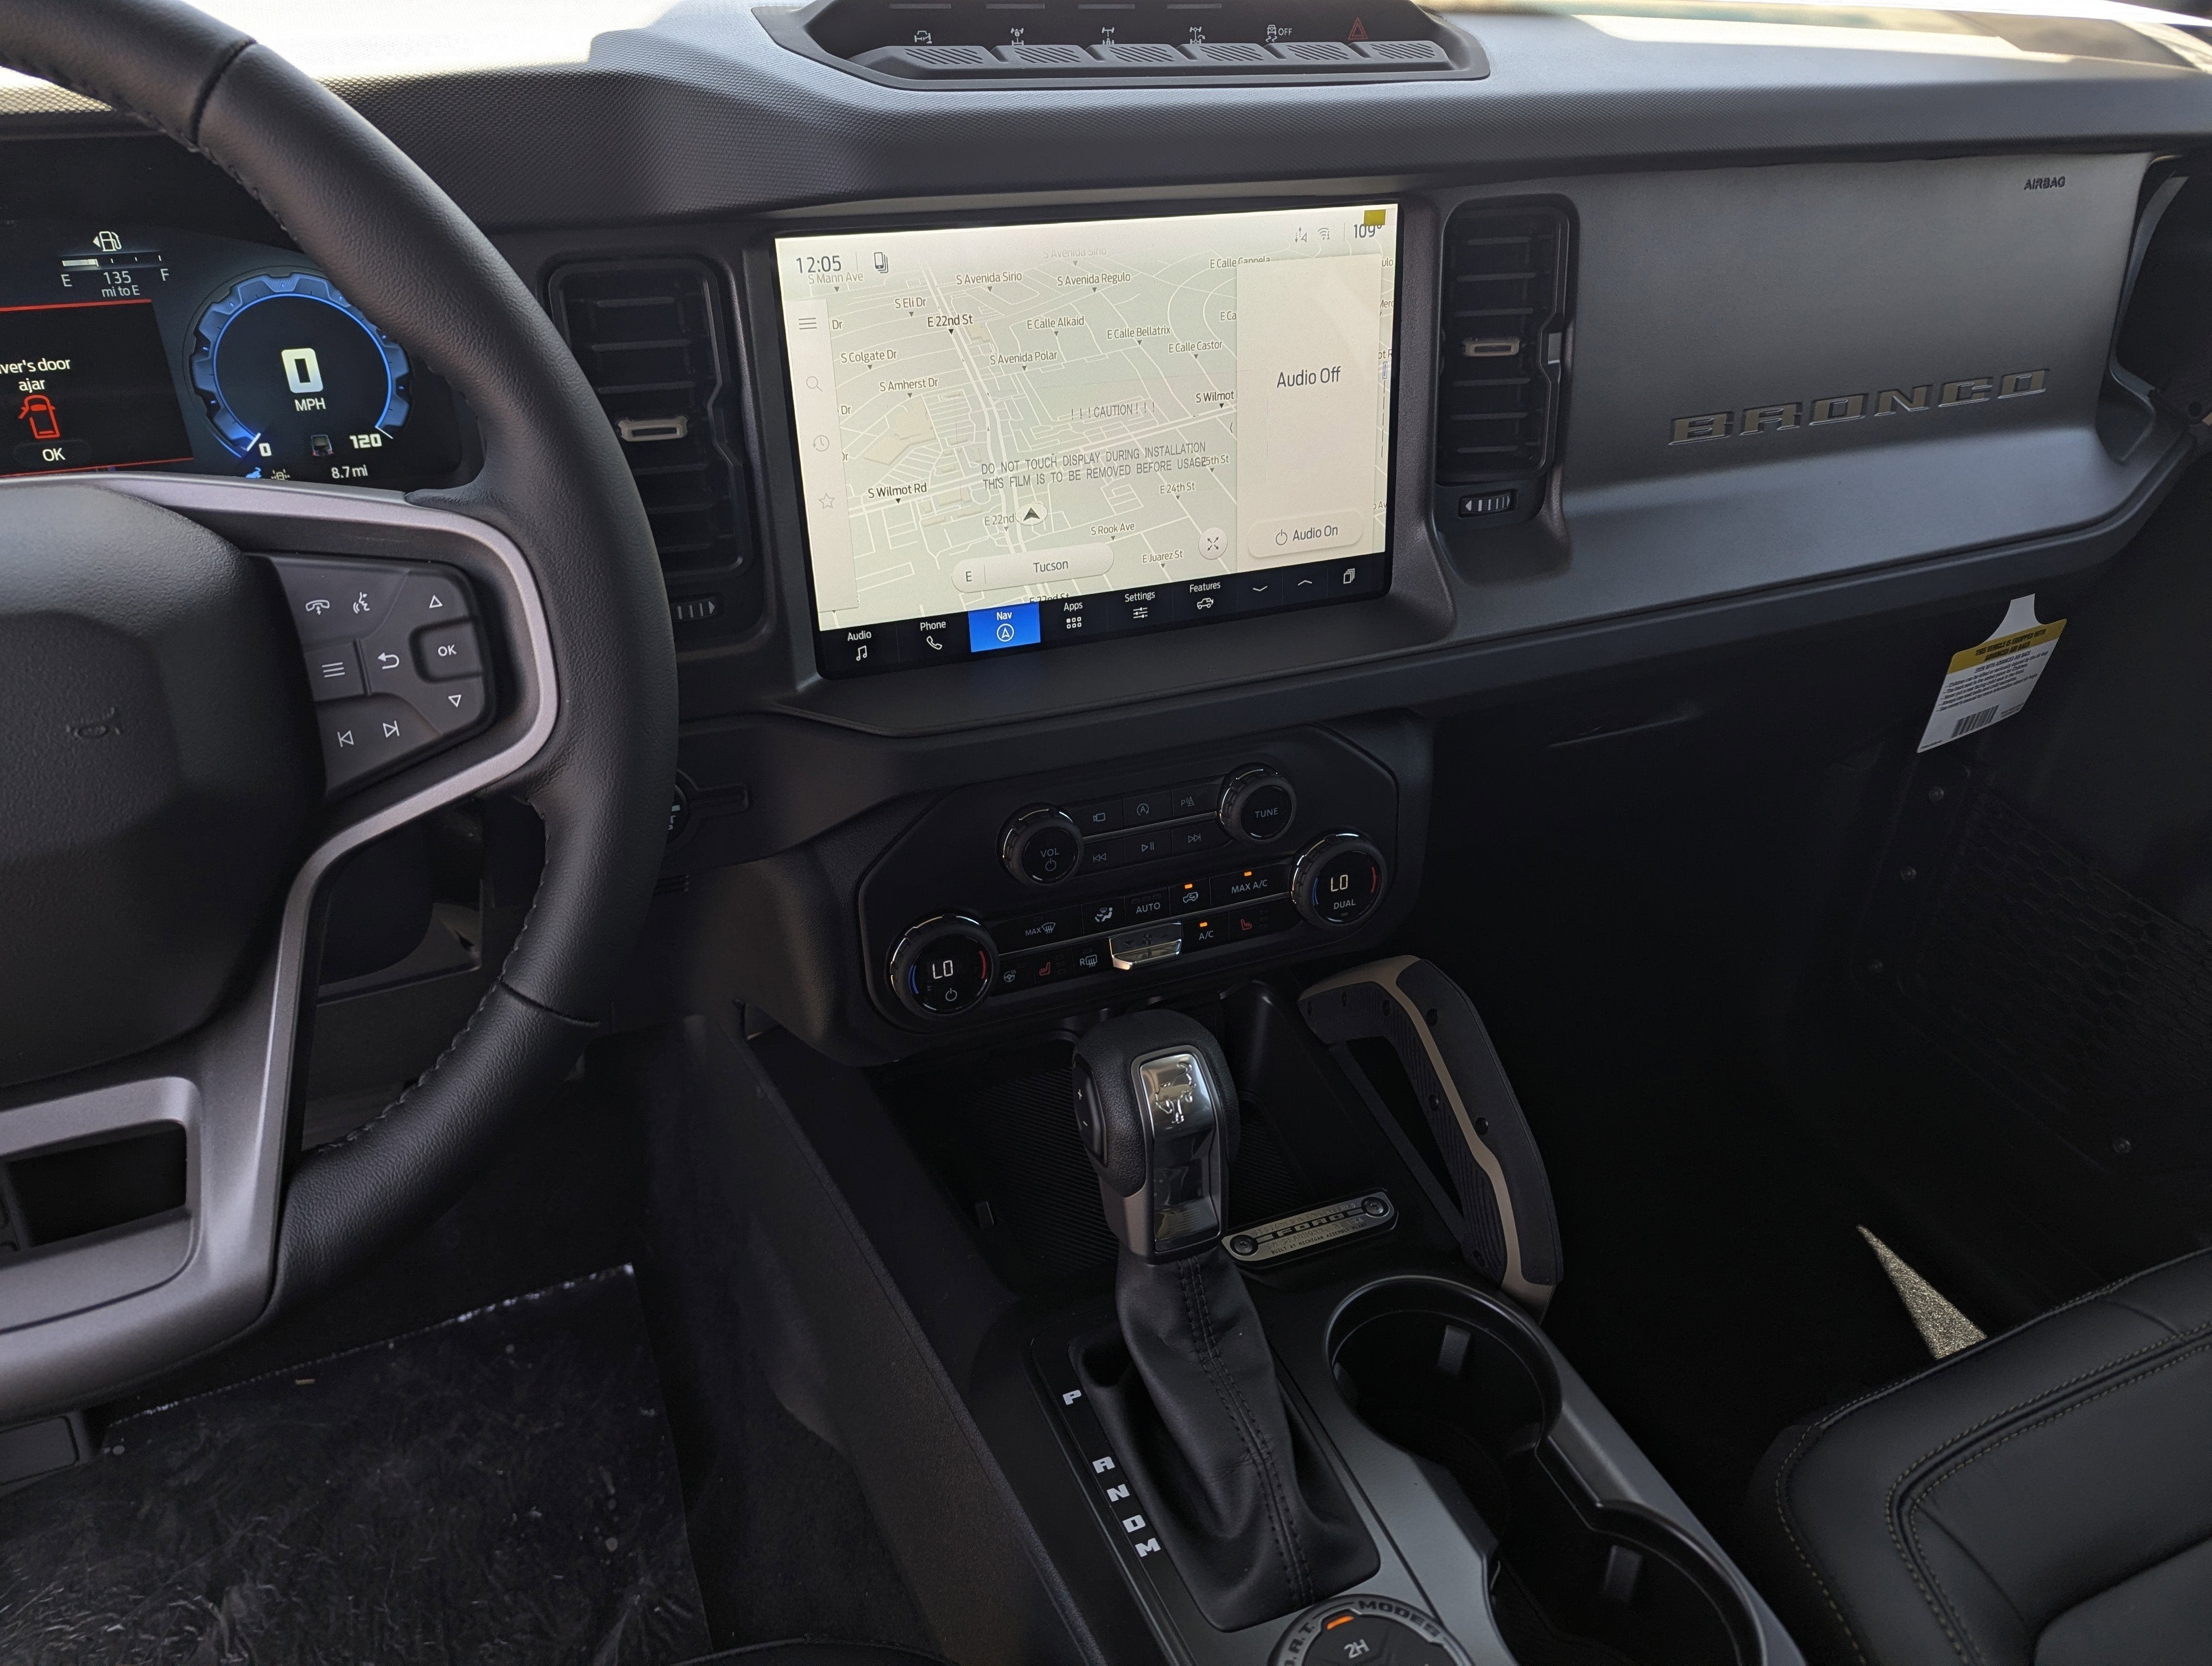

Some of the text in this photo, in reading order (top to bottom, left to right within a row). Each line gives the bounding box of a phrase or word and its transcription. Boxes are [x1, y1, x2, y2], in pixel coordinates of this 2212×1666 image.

[2024, 176, 2065, 190] AIRBAG
[796, 255, 841, 273] 12:05
[1211, 259, 1215, 268] E
[1217, 258, 1236, 268] Calle
[61, 274, 72, 287] E
[104, 271, 131, 284] 135
[160, 269, 169, 281] F
[808, 272, 864, 285] S Mann Ave
[956, 272, 1022, 285] S Avenida Sirio
[1057, 272, 1130, 286] S Avenida Regulo
[102, 285, 140, 297] mi to E
[895, 297, 927, 309] S Eli Dr
[928, 314, 973, 327] E 22nd St
[1027, 316, 1084, 329] E Calle Alkaid
[1220, 312, 1225, 321] E
[832, 320, 842, 330] Dr
[1107, 326, 1171, 339] E Calle Bellatrix
[1169, 340, 1223, 353] E Calle Castor
[841, 350, 897, 364] S Colgate Dr
[990, 350, 1057, 365] S Avenida Polar
[0, 358, 70, 374] ver's door
[281, 348, 323, 394] 0
[1277, 366, 1341, 388] Audio Off
[19, 378, 45, 393] ajar
[880, 379, 938, 391] S Amherst Dr
[1196, 393, 1201, 403] S
[1204, 390, 1234, 401] Wilmot
[295, 398, 326, 412] MPH
[841, 406, 851, 415] Dr
[1669, 368, 2049, 445] BRONCO
[350, 434, 382, 449] 120
[42, 448, 65, 462] OK
[259, 444, 272, 457] 0
[982, 442, 1206, 475] DO NOT TOUCH DISPLAY DURING INSTALLATION
[1221, 455, 1229, 464] St
[331, 464, 368, 479] 8.7 mi
[983, 457, 1206, 490] THIS FILM IS TO BE REMOVED BEFORE USAGE
[868, 483, 927, 498] S Wilmot Rd
[1160, 482, 1195, 494] E 24th St
[985, 517, 989, 526] E
[991, 514, 1014, 525] 22nd
[1091, 523, 1135, 536] S Rook Ave
[1293, 525, 1338, 541] Audio On
[1142, 550, 1183, 563] E Juarez St
[1033, 560, 1068, 573] Tucson
[966, 572, 972, 582] E
[1189, 581, 1220, 593] Features
[1125, 590, 1155, 603] Settings
[1064, 602, 1083, 612] Apps
[997, 612, 1012, 620] Nav
[921, 620, 946, 631] Phone
[847, 631, 871, 642] Audio
[438, 645, 456, 657] OK
[1255, 808, 1278, 818] TUNE
[1040, 848, 1059, 857] VOL
[1231, 879, 1268, 893] MAX A/C
[1136, 902, 1160, 913] AUTO
[1334, 899, 1355, 909] DUAL
[1025, 927, 1041, 936] MAX
[1199, 931, 1213, 940] A/C
[1276, 1213, 1344, 1236] FORD
[1299, 1236, 1323, 1246] MICHIGAN
[1326, 1228, 1349, 1238] ASSEMBLY
[1063, 1390, 1082, 1405] P
[1092, 1457, 1115, 1473] R
[1107, 1484, 1130, 1502] N
[1122, 1515, 1146, 1533] D
[1135, 1537, 1161, 1557] M
[1358, 1601, 1439, 1636] MODES
[1344, 1639, 1369, 1658] 2H
